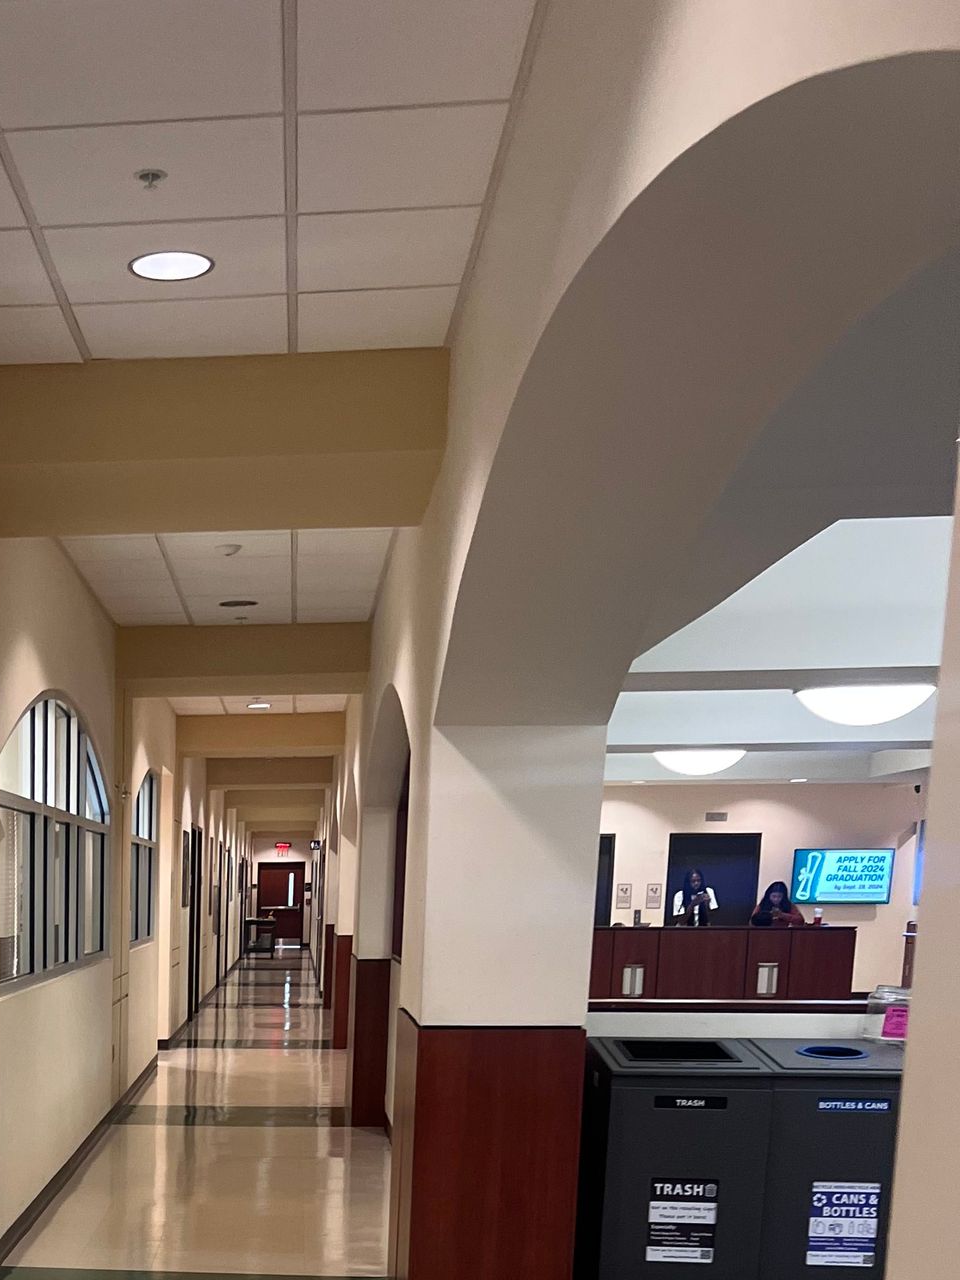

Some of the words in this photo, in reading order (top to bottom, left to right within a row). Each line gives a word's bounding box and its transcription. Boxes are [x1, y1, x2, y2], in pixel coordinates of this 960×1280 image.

[675, 1099, 705, 1107] TRASH
[819, 1101, 855, 1109] BOTTLES
[865, 1102, 888, 1110] CANS
[654, 1183, 703, 1196] TRASH
[832, 1193, 867, 1204] CANS
[869, 1194, 879, 1205] &
[822, 1206, 877, 1217] BOTTLES
